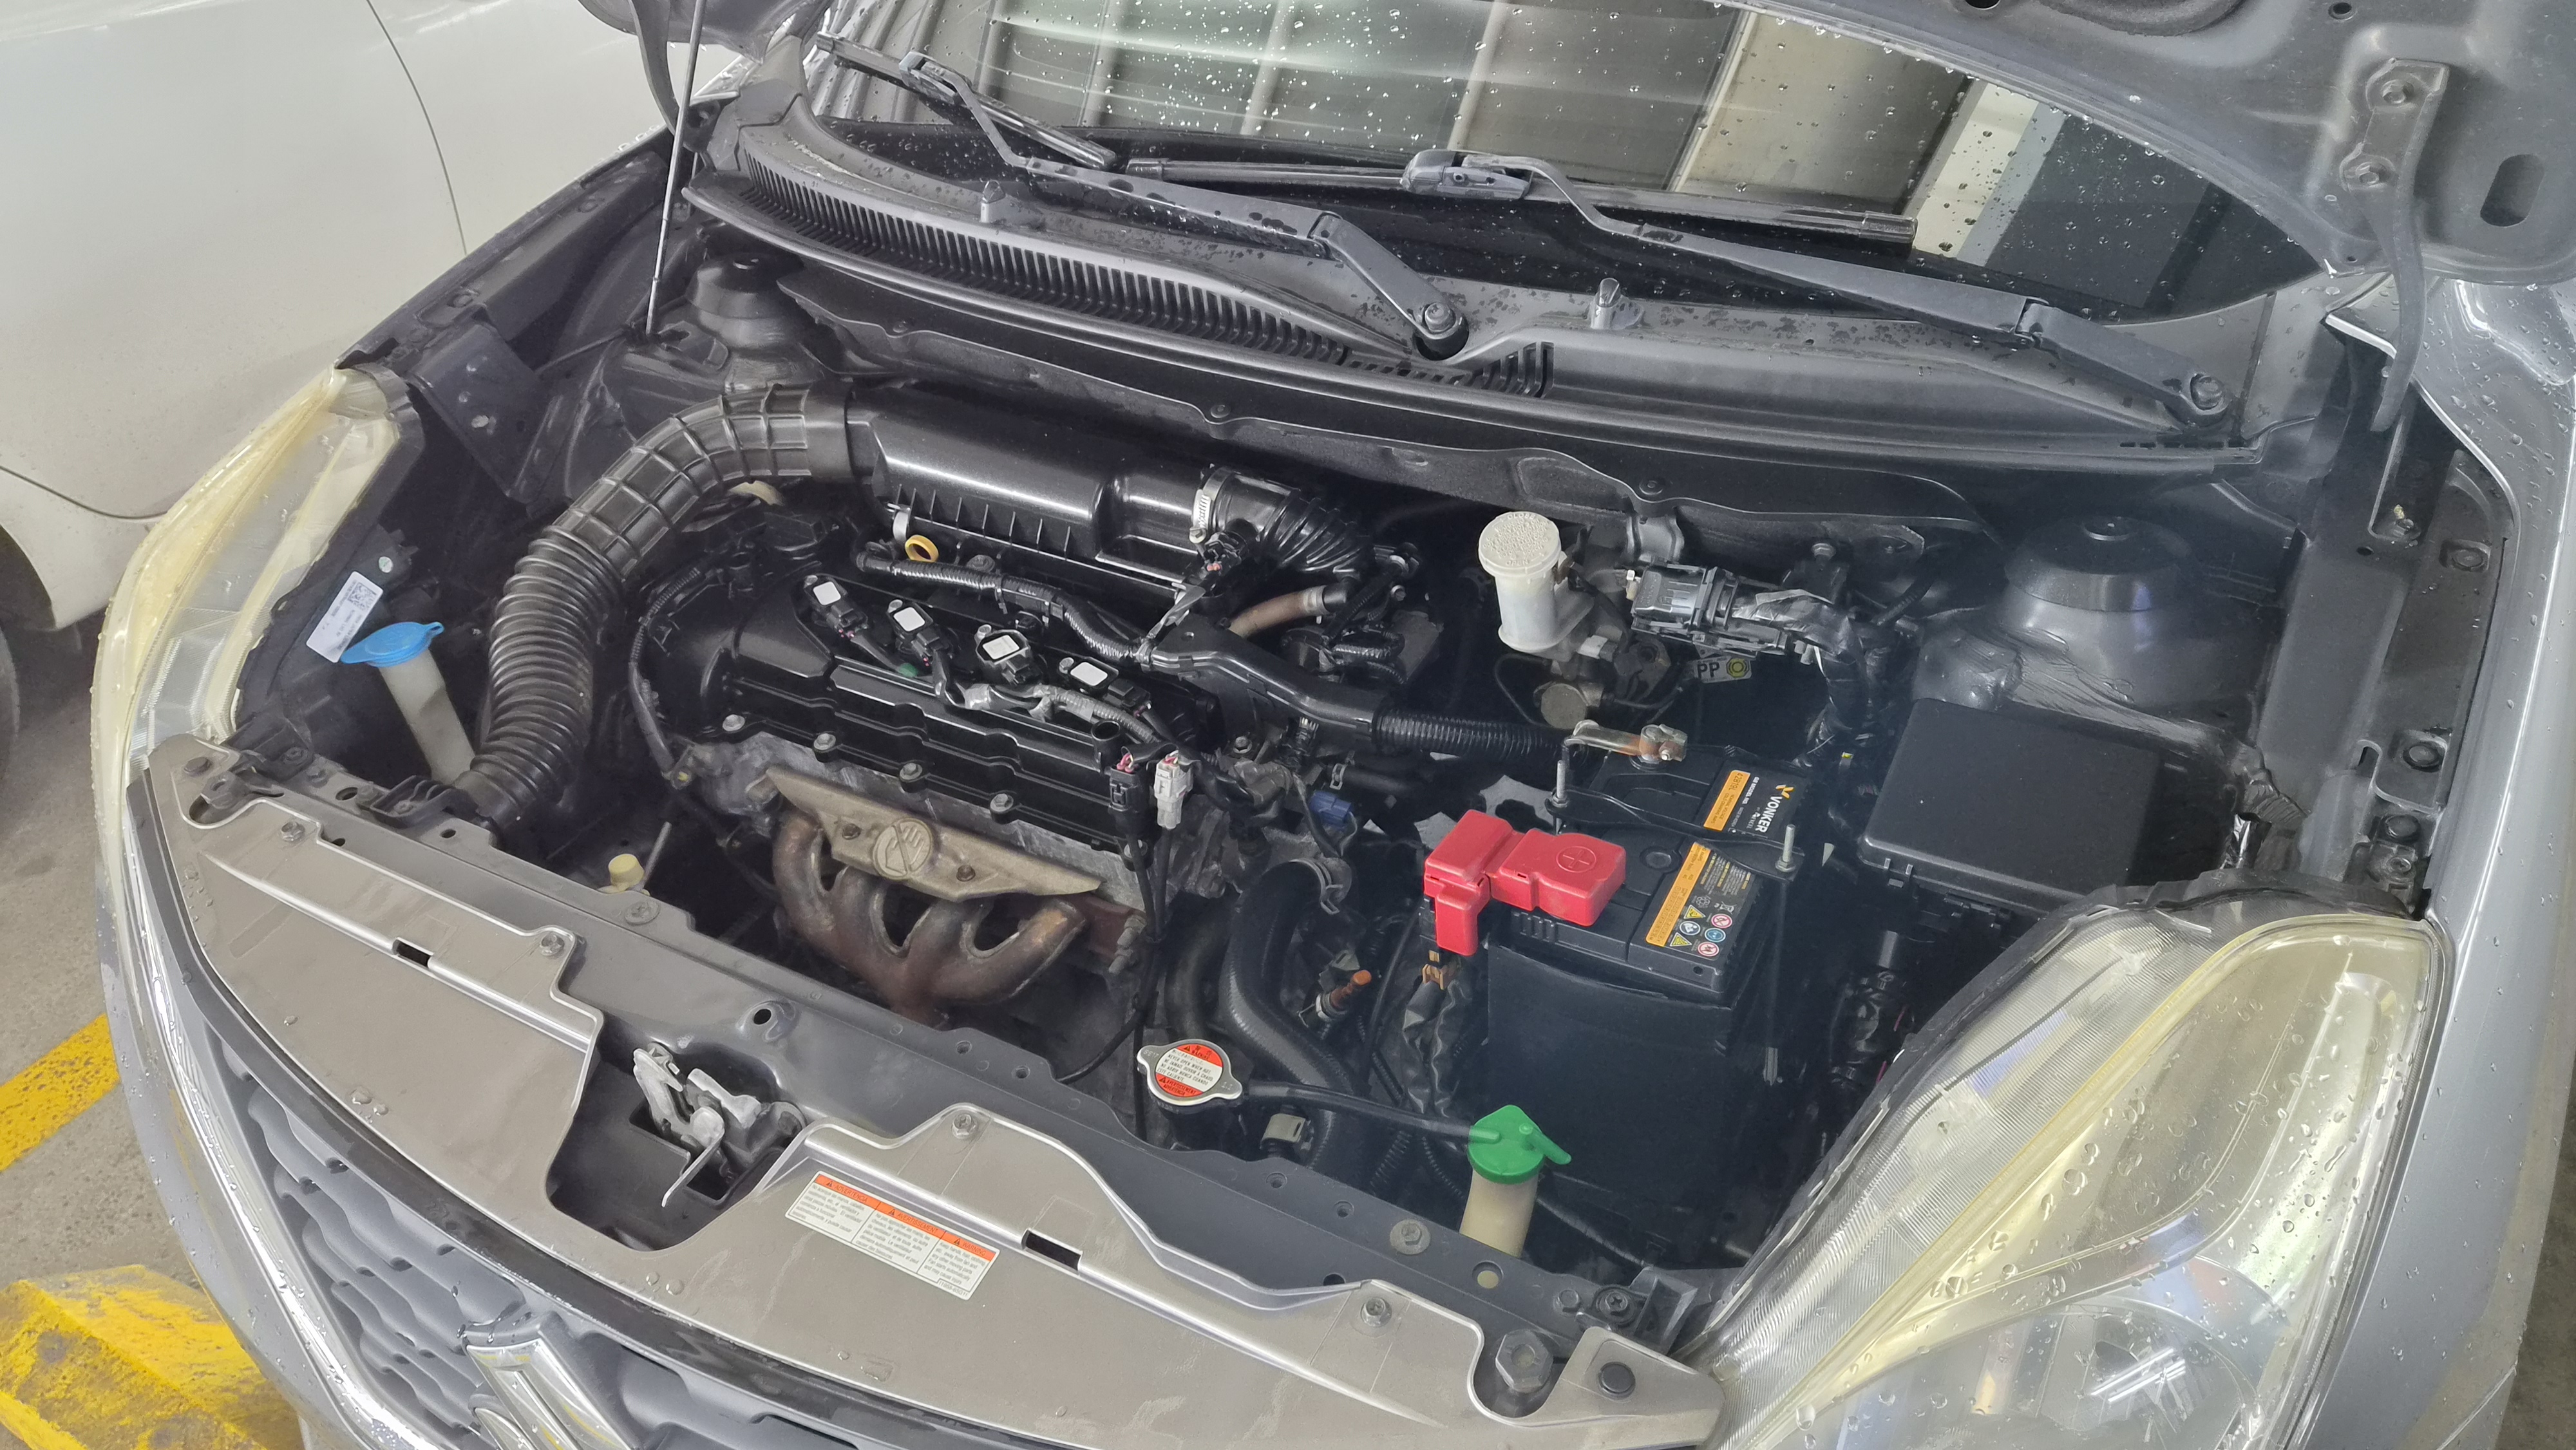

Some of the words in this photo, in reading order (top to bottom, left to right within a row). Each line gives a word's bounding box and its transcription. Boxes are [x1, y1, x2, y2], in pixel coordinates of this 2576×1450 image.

[1697, 662, 1719, 679] PP
[1754, 796, 1783, 833] VONKER
[1183, 1066, 1197, 1075] OUVRIR
[1163, 1084, 1185, 1095] ADVERTENCIA
[1166, 1079, 1197, 1095] AVERTISSEMENT
[1192, 1077, 1209, 1086] CUANDO
[835, 1185, 869, 1202] ADVERTENCIA
[897, 1213, 938, 1234] AVERTISSEMENT
[962, 1243, 987, 1256] WARNING
